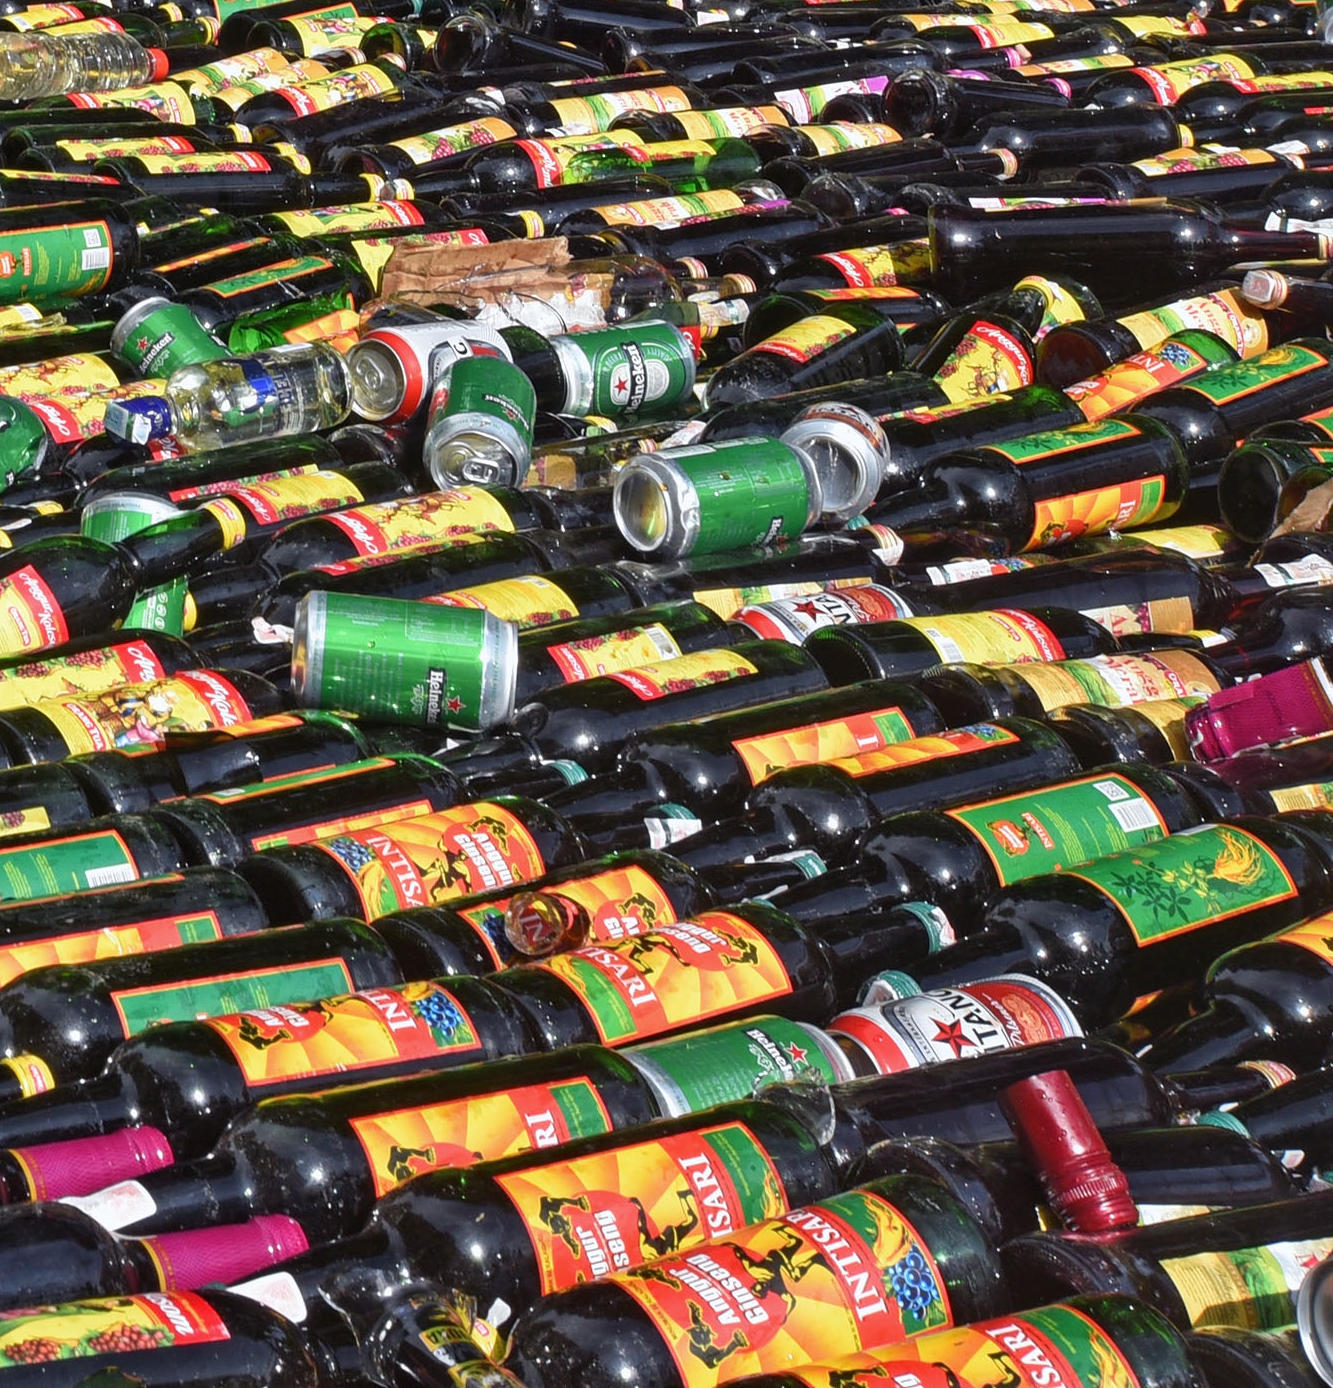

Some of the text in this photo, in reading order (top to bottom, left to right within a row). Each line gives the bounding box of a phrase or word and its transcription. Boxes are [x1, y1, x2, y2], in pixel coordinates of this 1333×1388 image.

[19, 571, 49, 614] Anggur
[20, 629, 31, 644] TUA
[67, 703, 105, 752] ORANG TUA
[668, 1268, 741, 1325] Anggur
[686, 1253, 769, 1325] Ginseng
